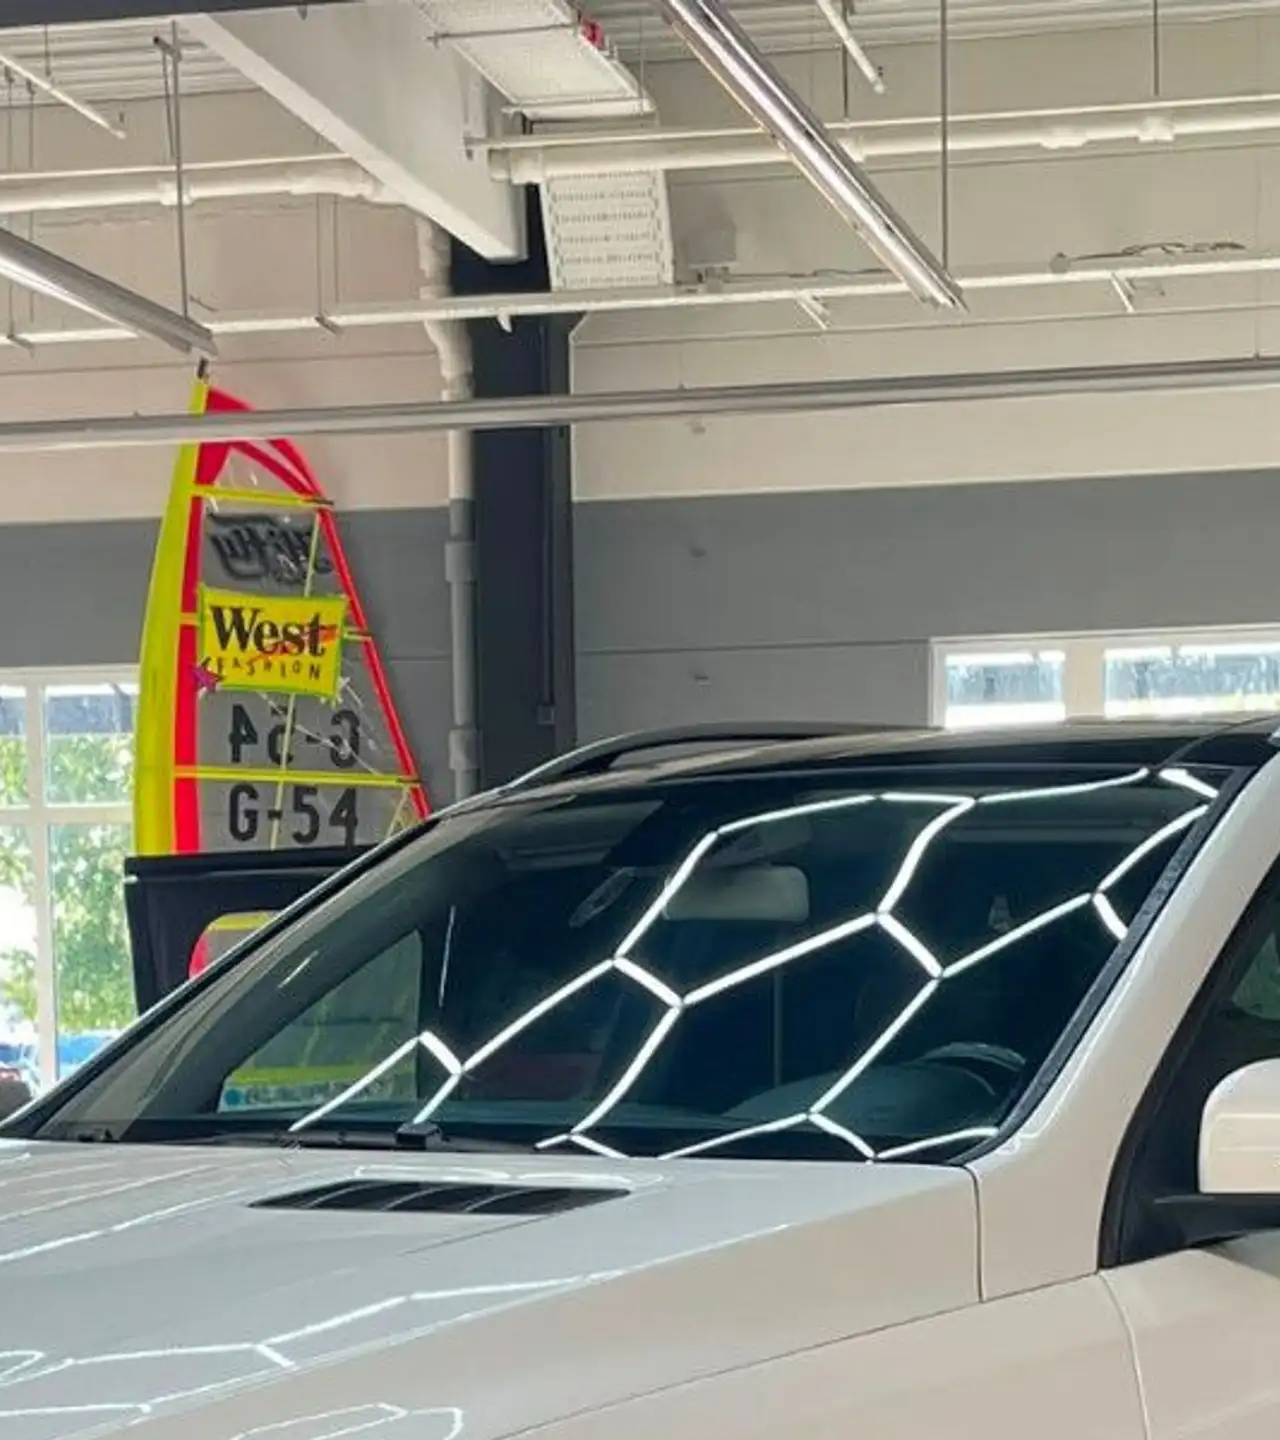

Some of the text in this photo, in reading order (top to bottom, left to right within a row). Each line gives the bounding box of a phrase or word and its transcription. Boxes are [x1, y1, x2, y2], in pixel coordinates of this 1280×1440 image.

[209, 604, 327, 657] West
[215, 656, 321, 681] FASHION
[228, 783, 359, 849] G-54
